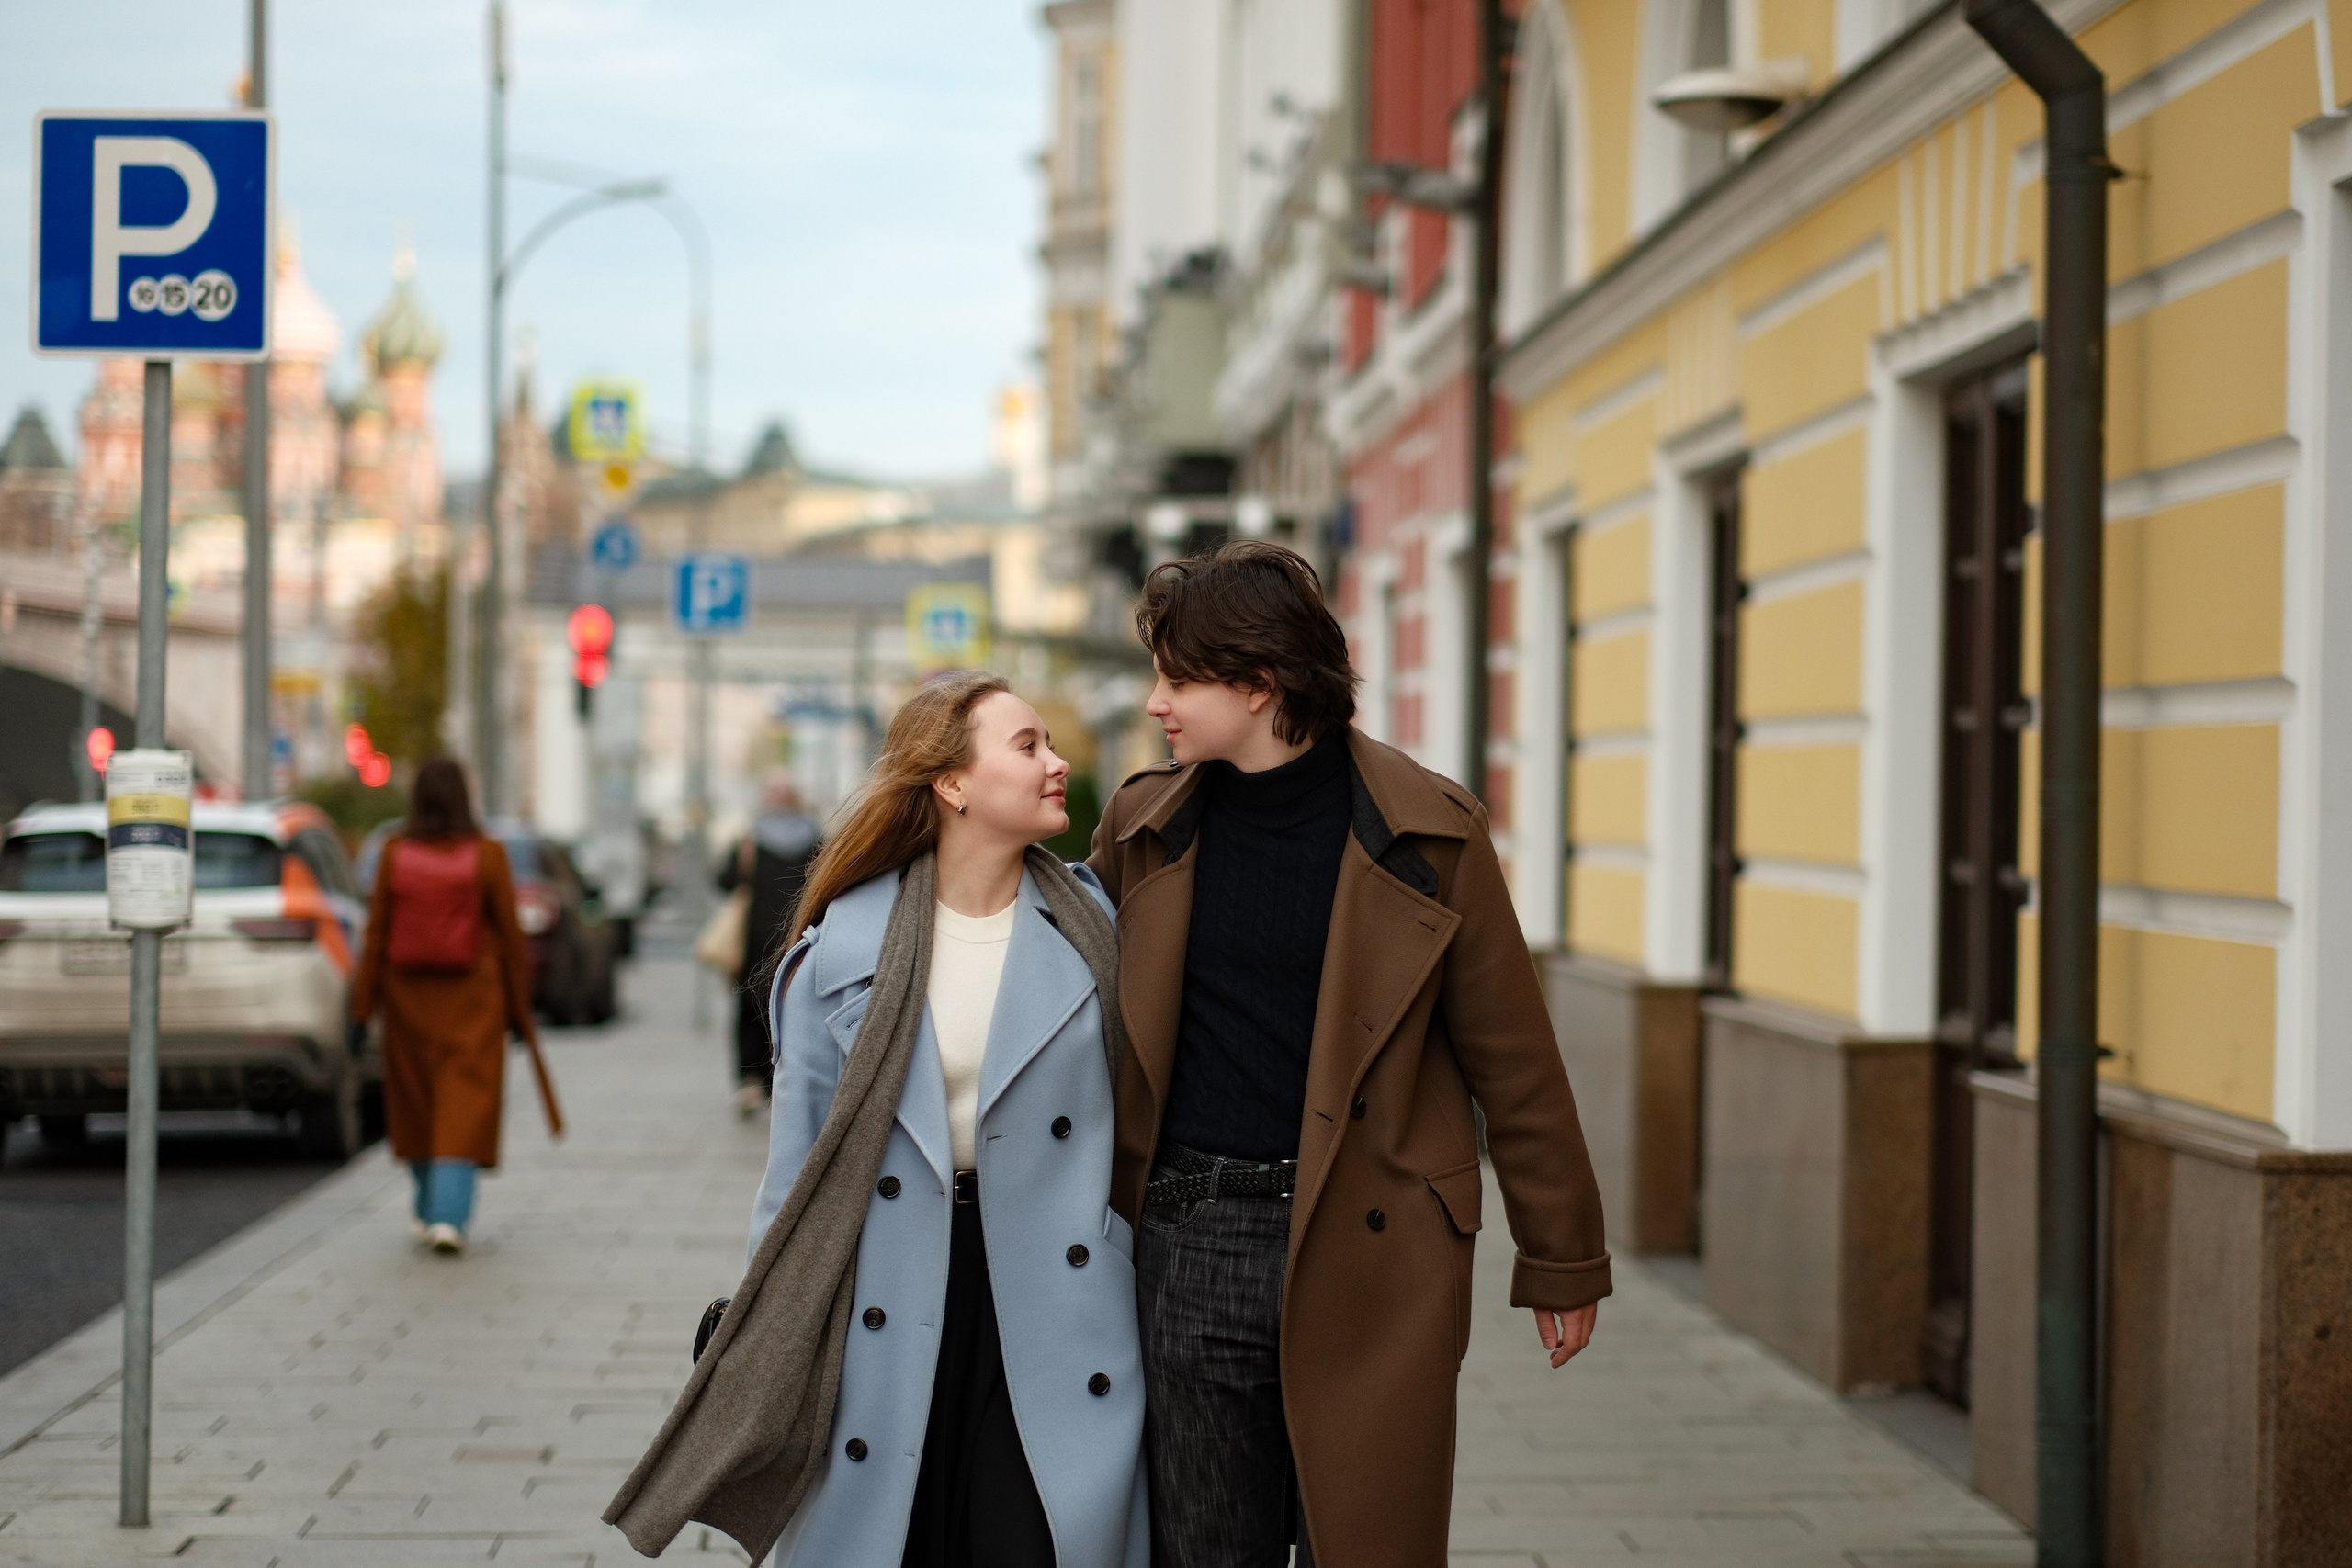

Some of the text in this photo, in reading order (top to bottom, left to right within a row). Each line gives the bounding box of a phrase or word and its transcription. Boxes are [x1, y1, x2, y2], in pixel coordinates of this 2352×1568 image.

[91, 136, 217, 321] P
[164, 283, 186, 307] 15
[197, 279, 232, 310] 20
[692, 563, 733, 628] P
